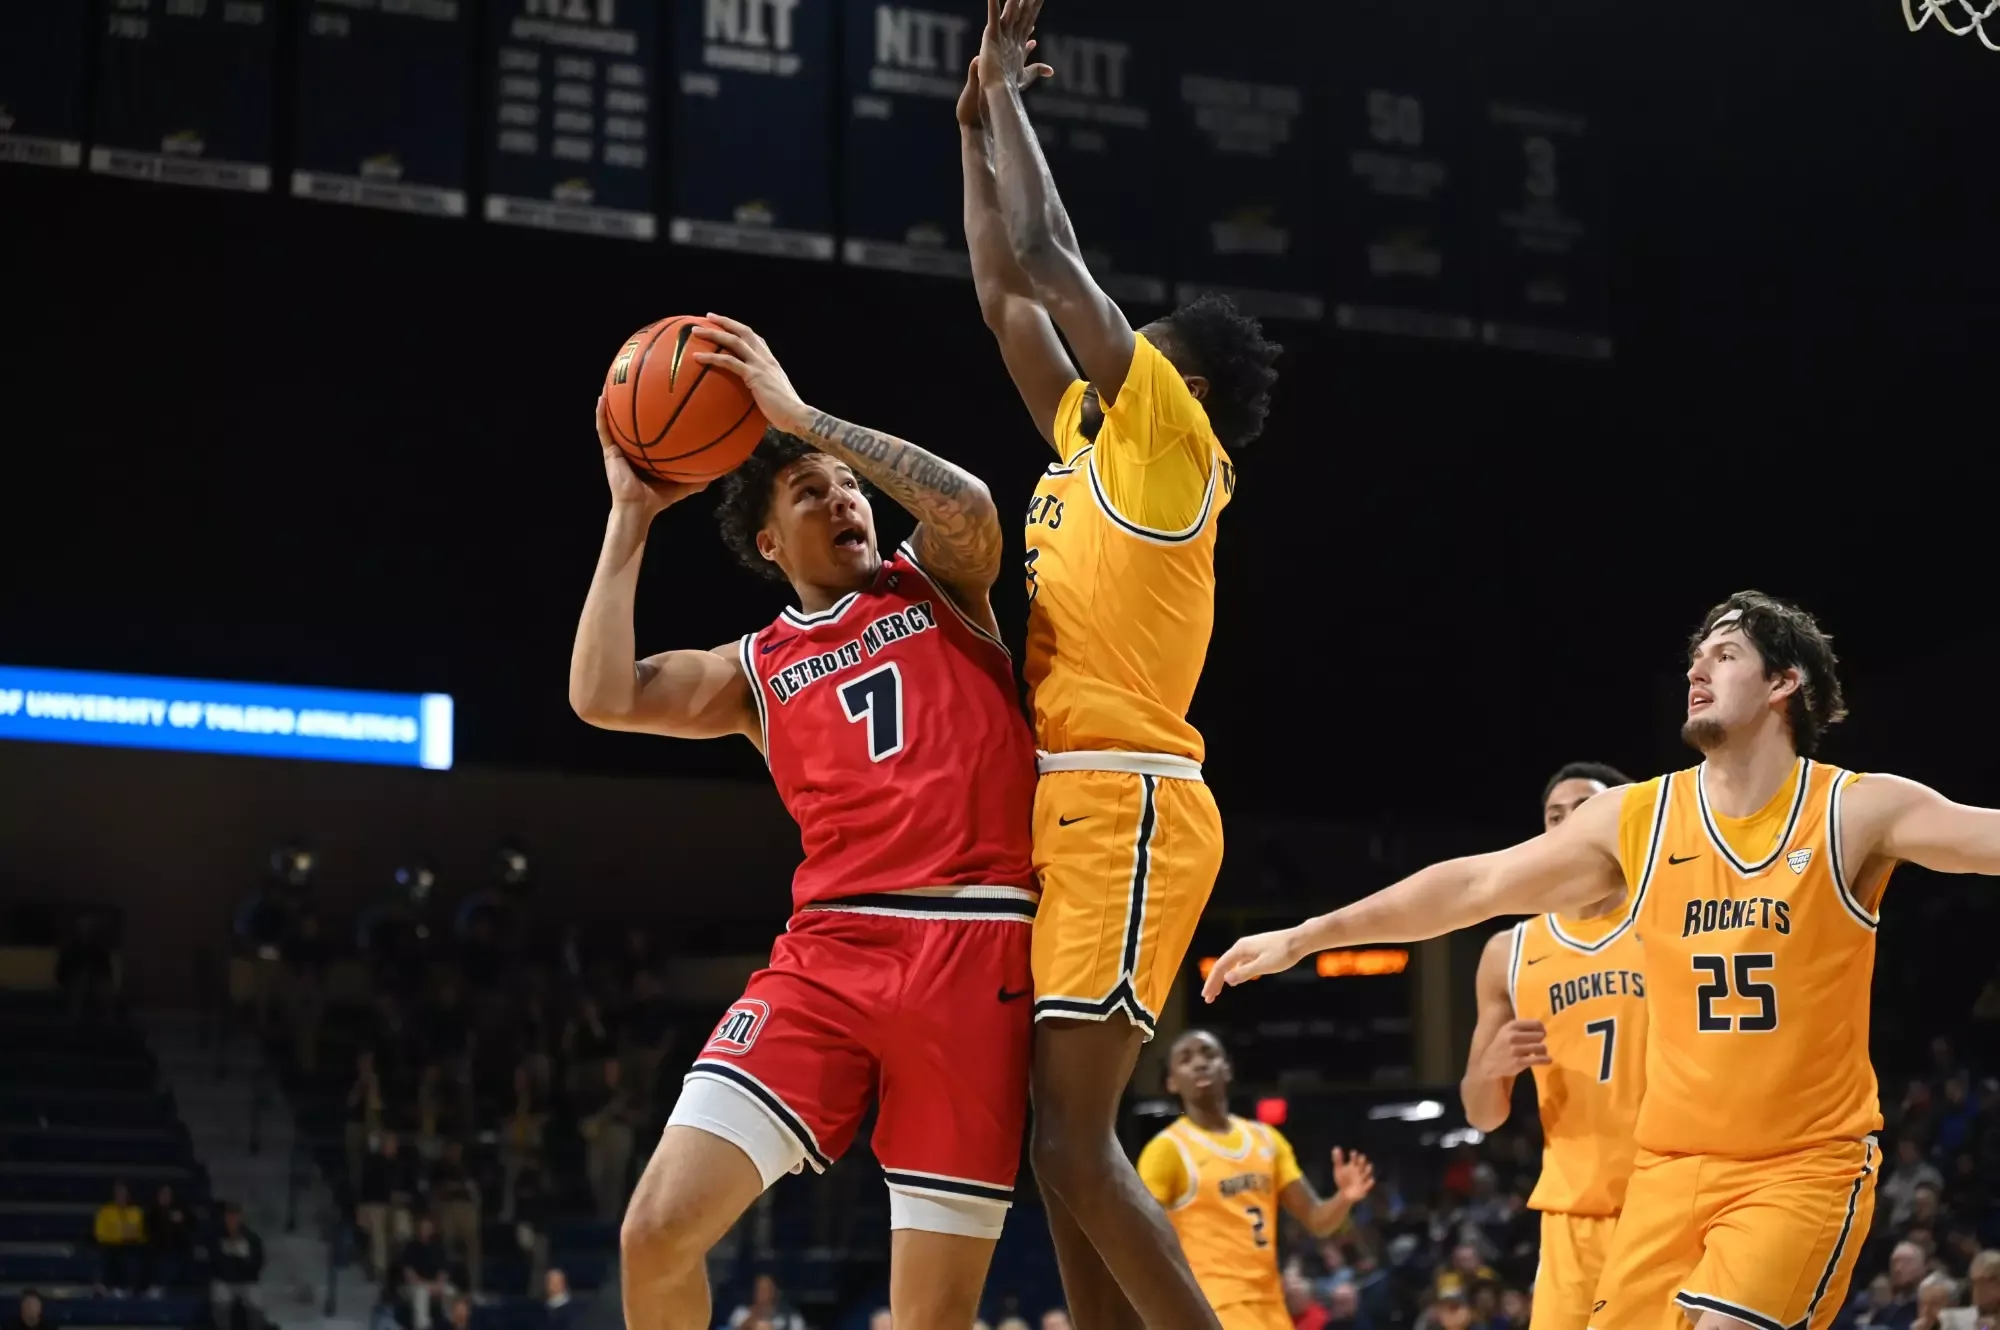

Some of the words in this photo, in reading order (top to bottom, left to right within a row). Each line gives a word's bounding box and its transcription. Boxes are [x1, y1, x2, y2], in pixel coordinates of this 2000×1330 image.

[703, 0, 799, 50] NIT
[874, 5, 972, 72] NIT
[810, 413, 840, 440] IN
[841, 427, 890, 462] GOD
[767, 638, 862, 706] DETROIT
[861, 600, 938, 658] MERCY
[836, 661, 904, 763] 7
[1681, 897, 1791, 938] ROCKETS
[1548, 970, 1646, 1016] ROCKETS
[1691, 952, 1778, 1033] 25
[1585, 1017, 1617, 1083] 7
